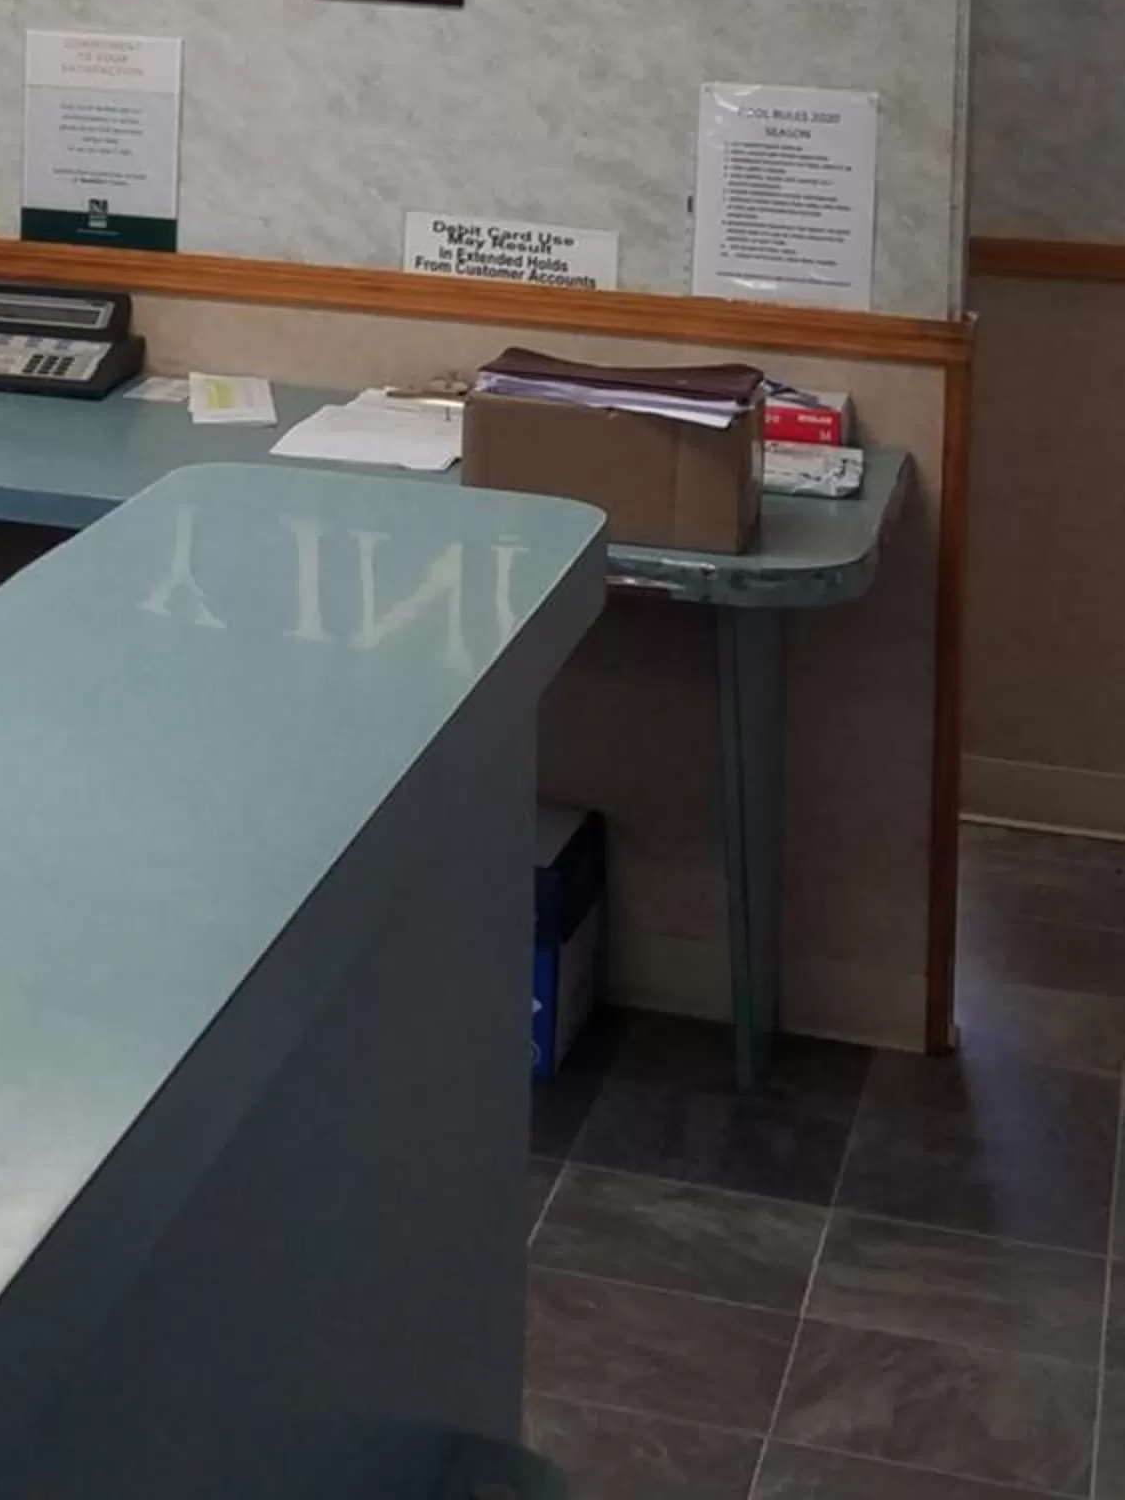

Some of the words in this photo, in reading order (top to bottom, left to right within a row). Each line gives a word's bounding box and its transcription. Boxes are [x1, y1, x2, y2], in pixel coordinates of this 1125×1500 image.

[432, 220, 481, 236] Debit
[487, 227, 532, 242] Card
[539, 231, 575, 247] Use
[447, 232, 486, 250] May
[491, 234, 552, 255] Result
[414, 255, 452, 273] From
[455, 261, 526, 280] Customer
[527, 268, 597, 290] Accounts
[438, 245, 452, 260] In
[456, 247, 523, 268] Extended
[528, 256, 568, 273] Holds
